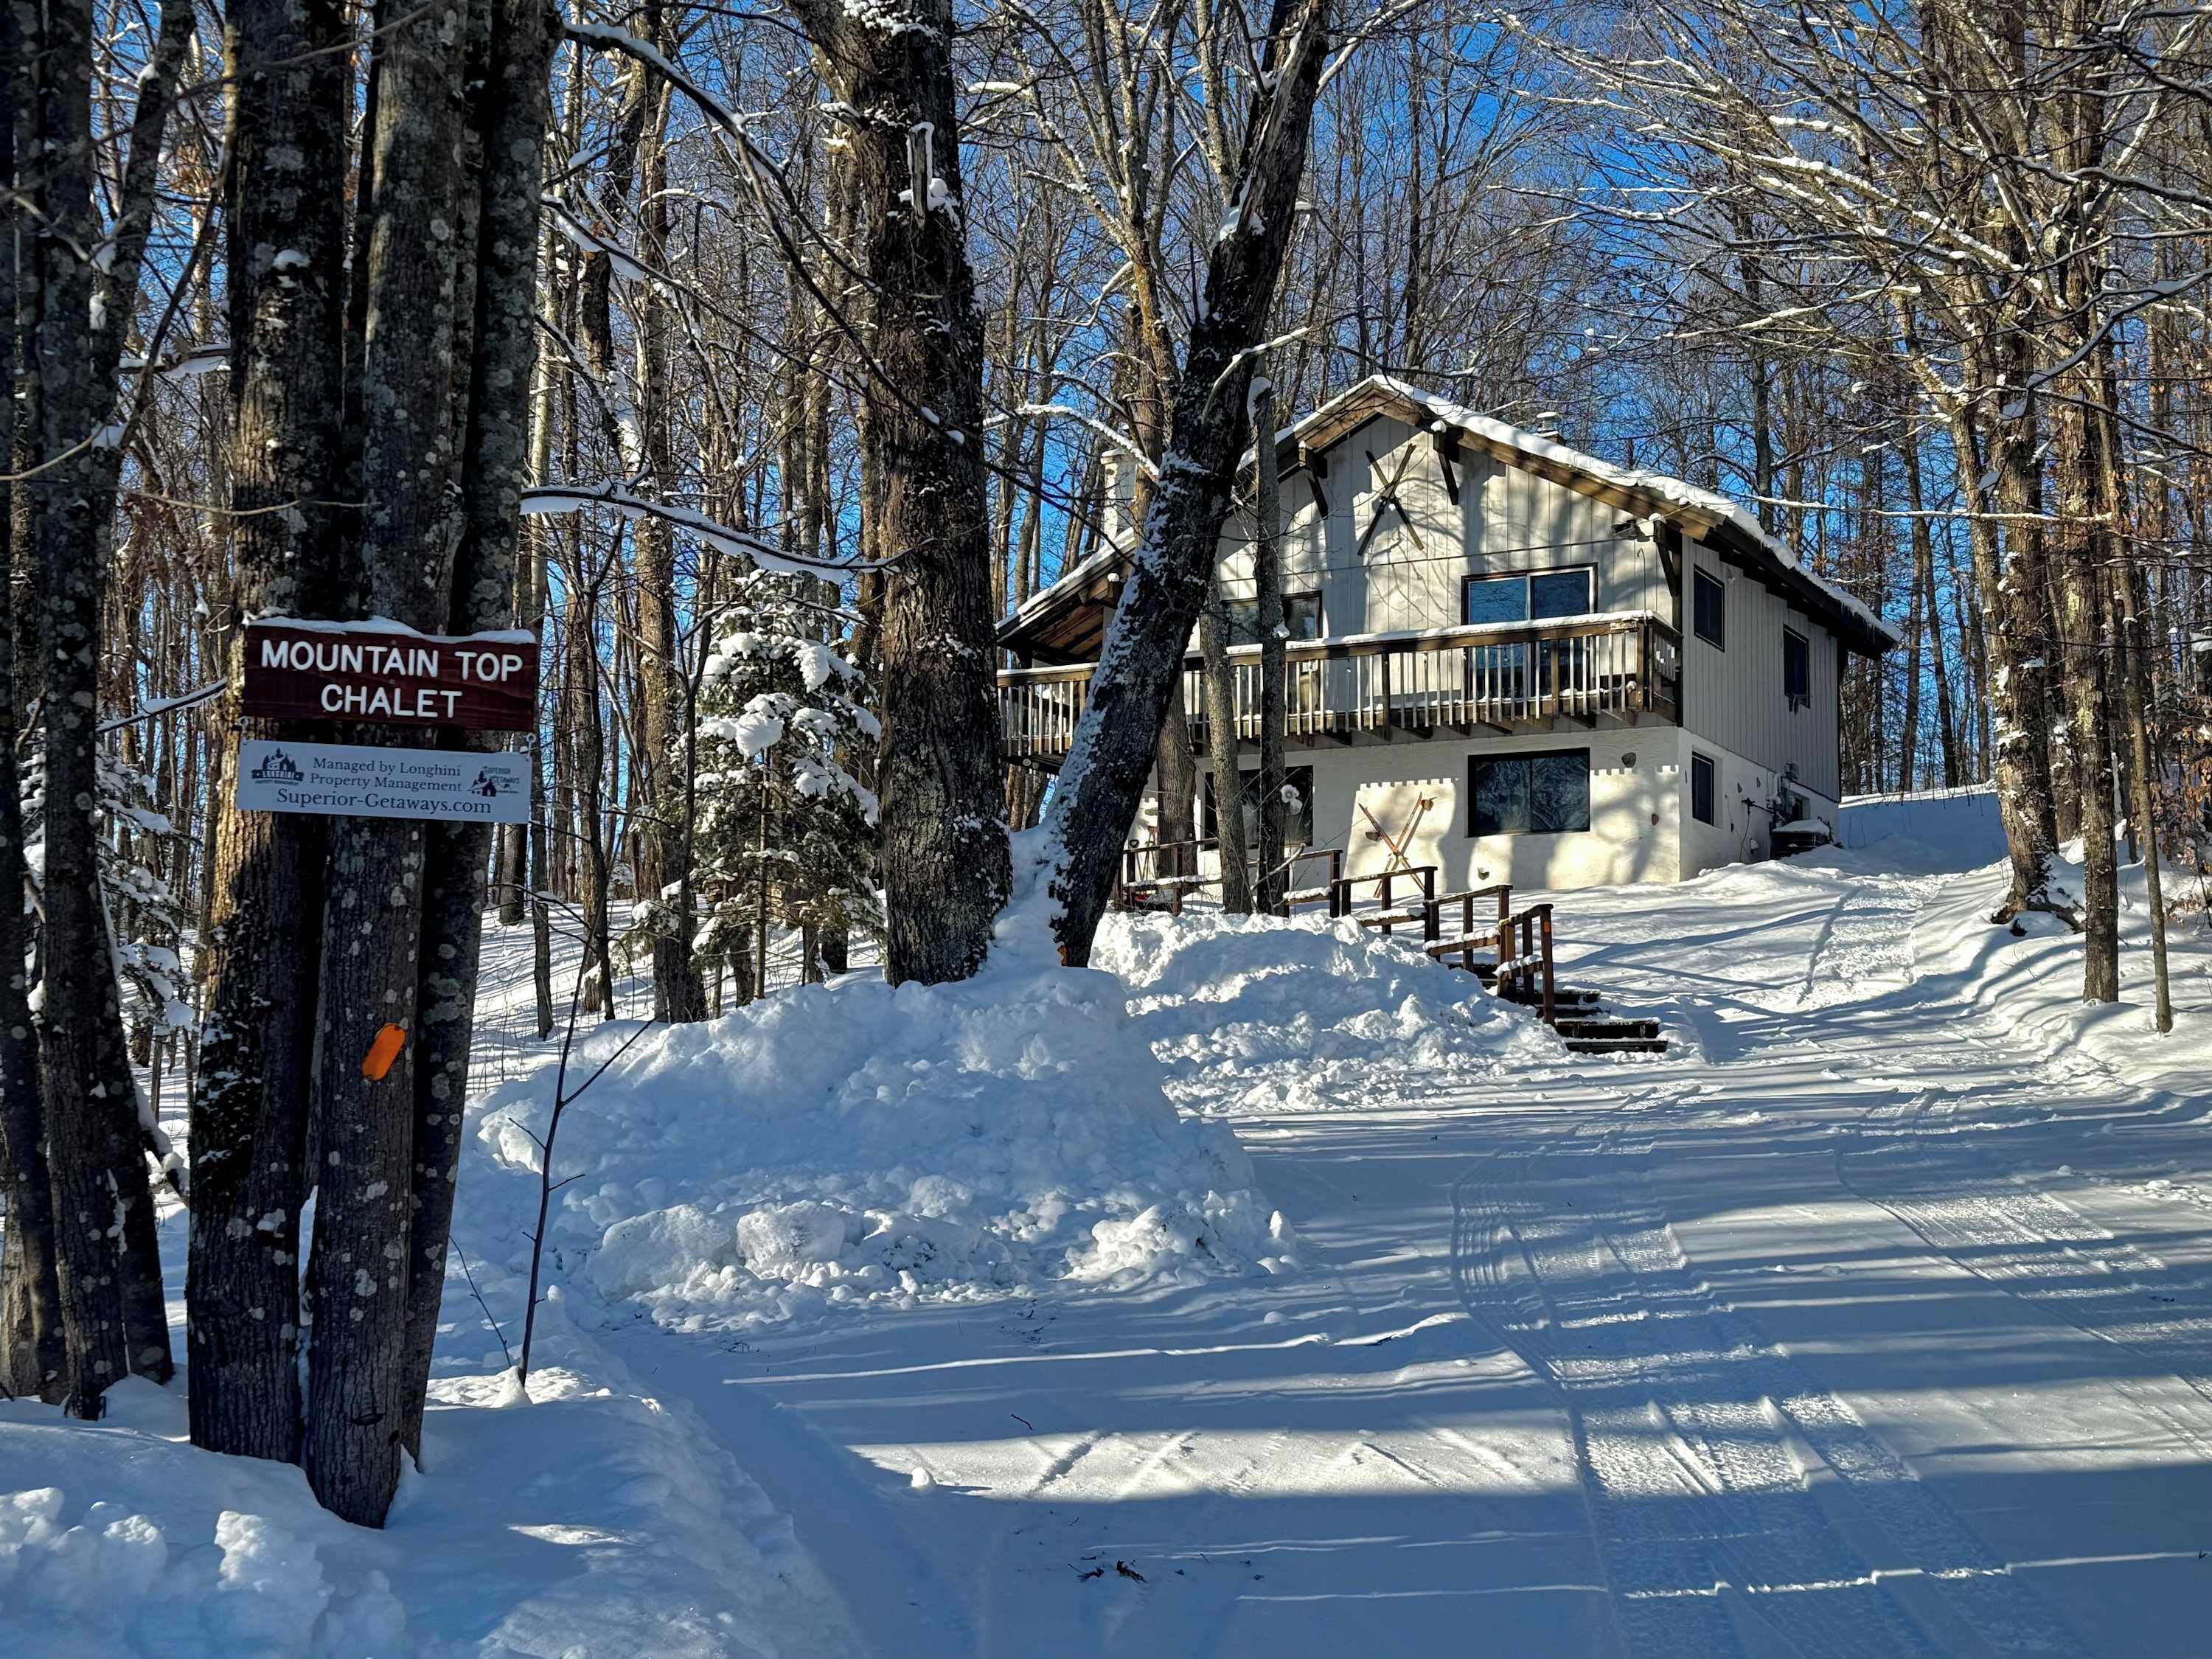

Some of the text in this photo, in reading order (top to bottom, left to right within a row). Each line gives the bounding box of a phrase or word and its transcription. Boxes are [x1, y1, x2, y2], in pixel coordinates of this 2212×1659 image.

[261, 639, 524, 682] MOUNTAIN TOP
[321, 684, 463, 718] CHALET
[313, 757, 461, 778] Managed by Longhini
[310, 773, 370, 790] Property
[375, 776, 462, 792] Management
[277, 788, 491, 815] Superior-Getaways.com
